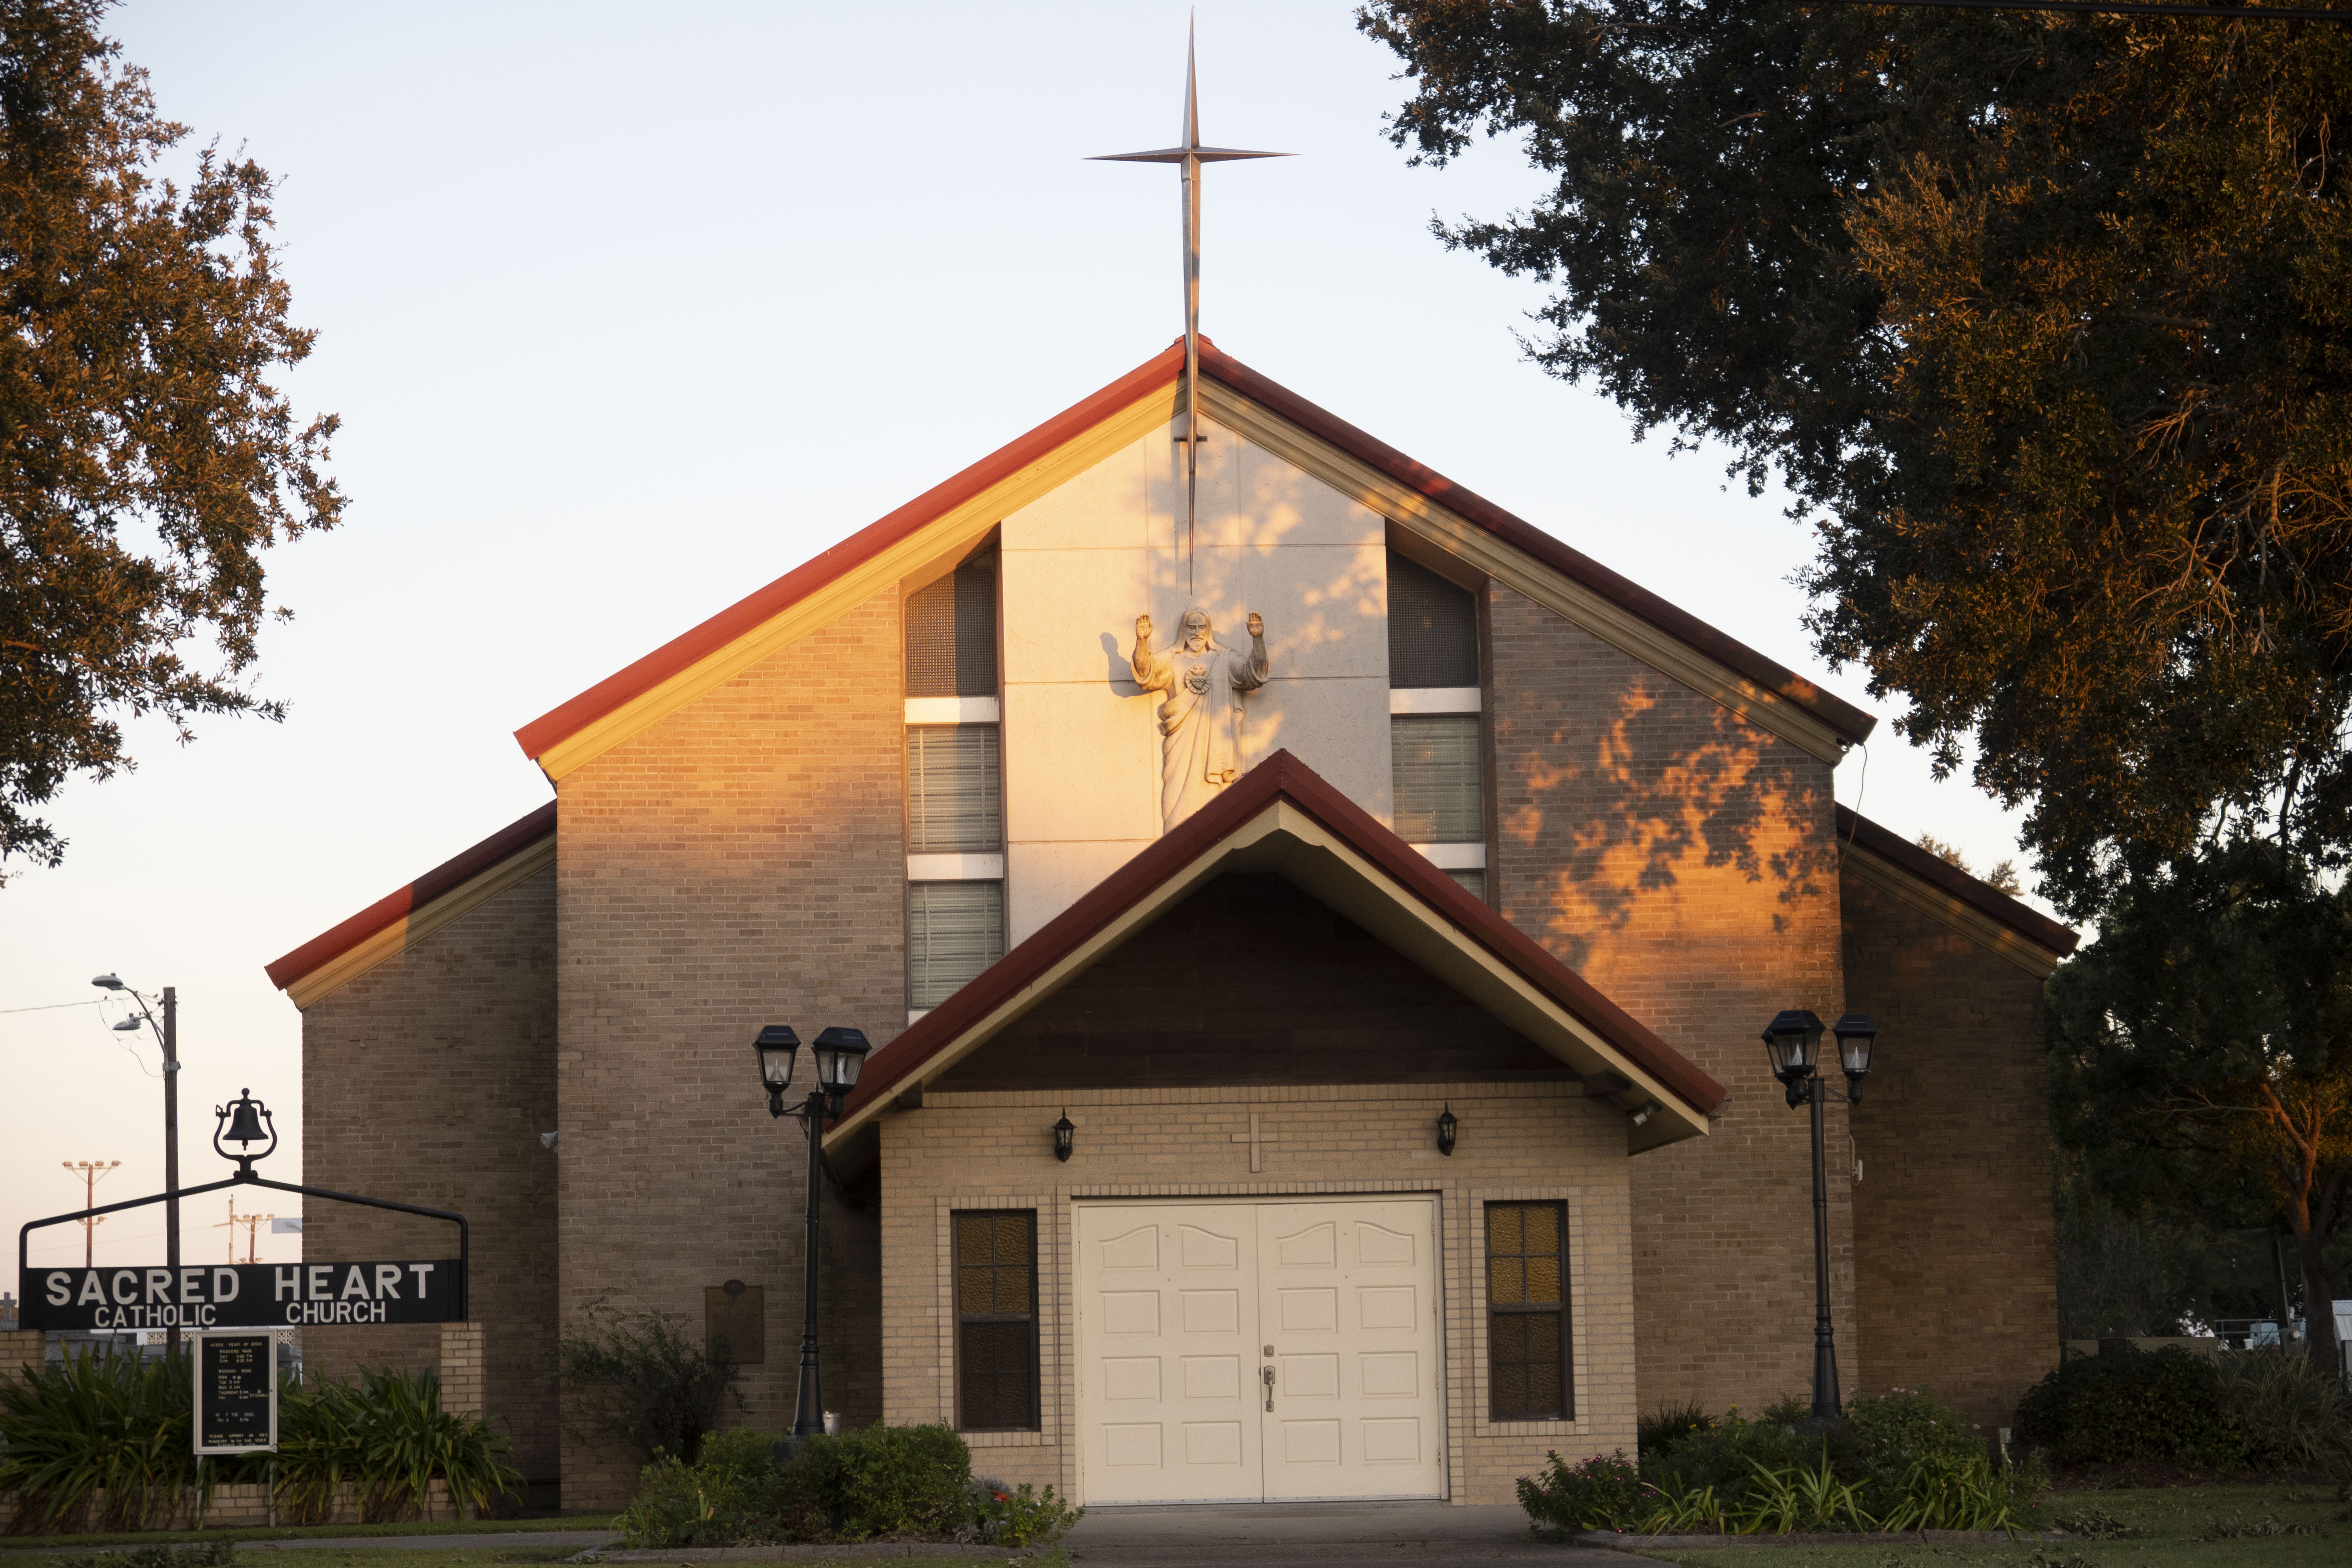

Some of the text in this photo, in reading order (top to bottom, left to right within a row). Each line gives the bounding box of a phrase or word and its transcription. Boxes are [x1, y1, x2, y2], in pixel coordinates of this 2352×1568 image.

[46, 1264, 435, 1306] SACRED HEART
[95, 1301, 385, 1327] CATHOLIC CHURCH
